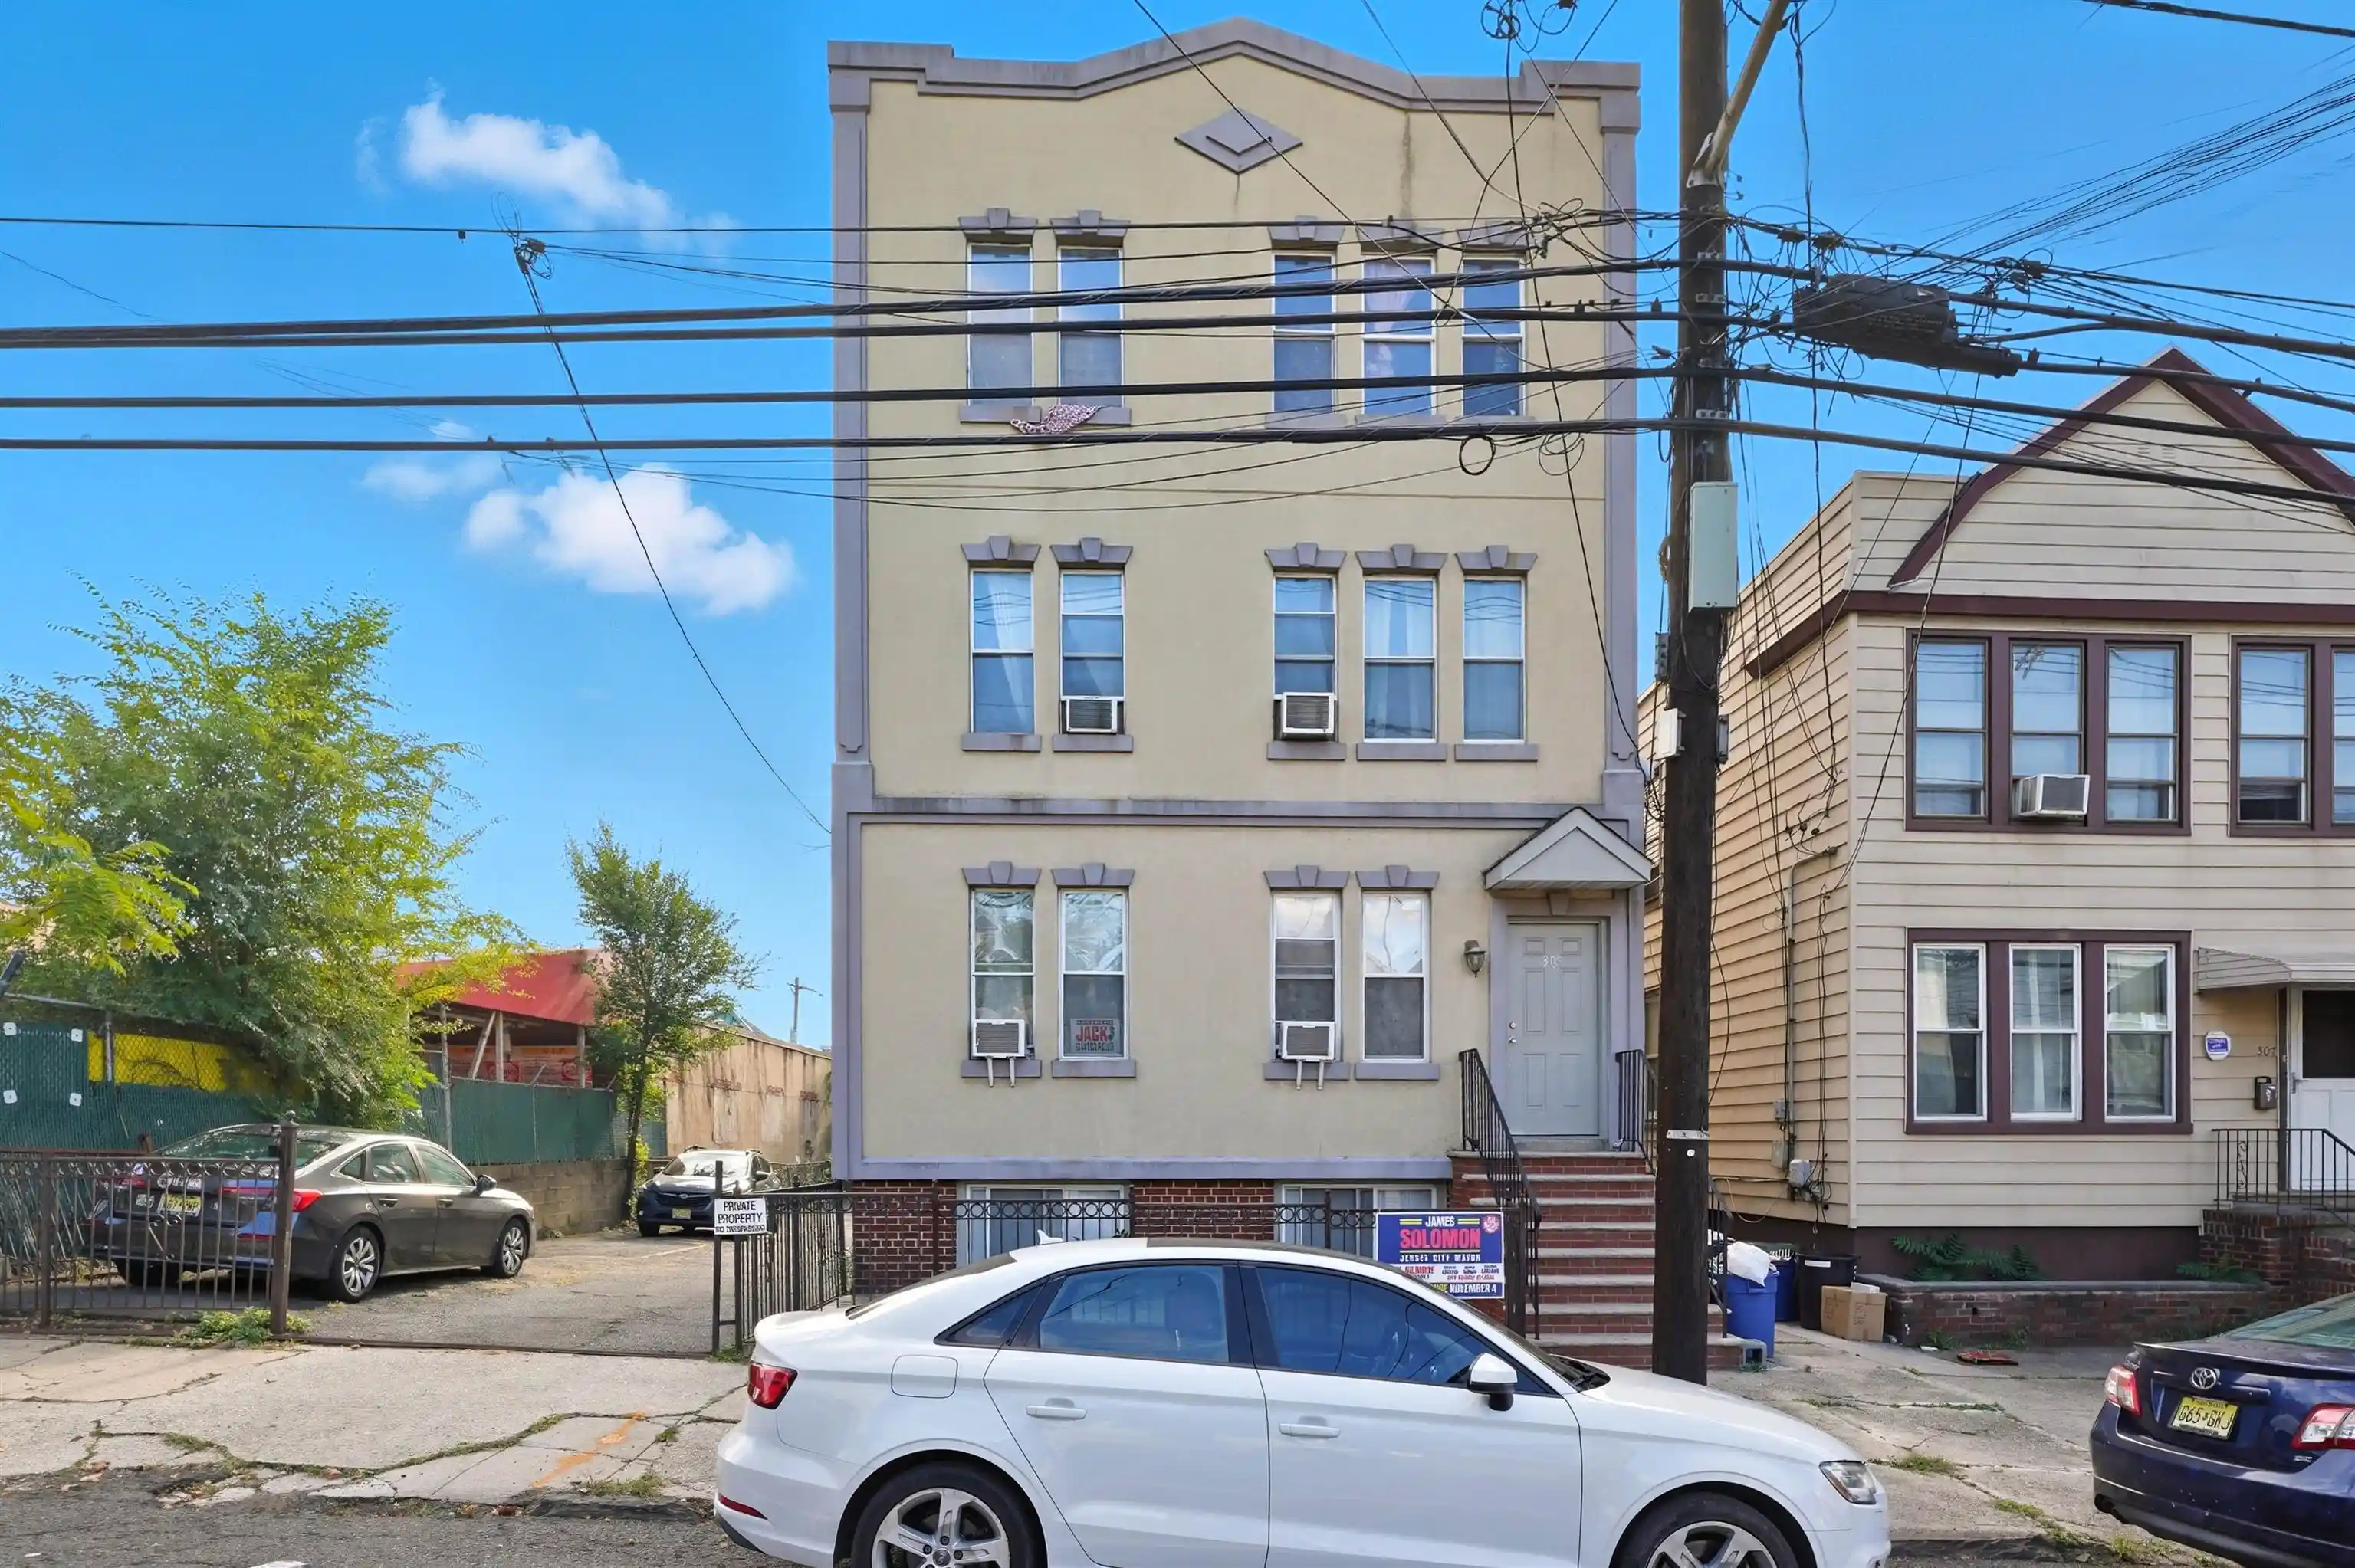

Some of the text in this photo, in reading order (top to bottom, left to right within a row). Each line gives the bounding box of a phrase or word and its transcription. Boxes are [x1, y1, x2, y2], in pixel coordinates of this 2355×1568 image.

[723, 1200, 757, 1212] PRIVATE
[718, 1212, 763, 1224] PROPERTY
[1424, 1215, 1455, 1227] JAMES
[1399, 1228, 1481, 1249] SOLOMON
[1449, 1283, 1490, 1294] NOVEMBER
